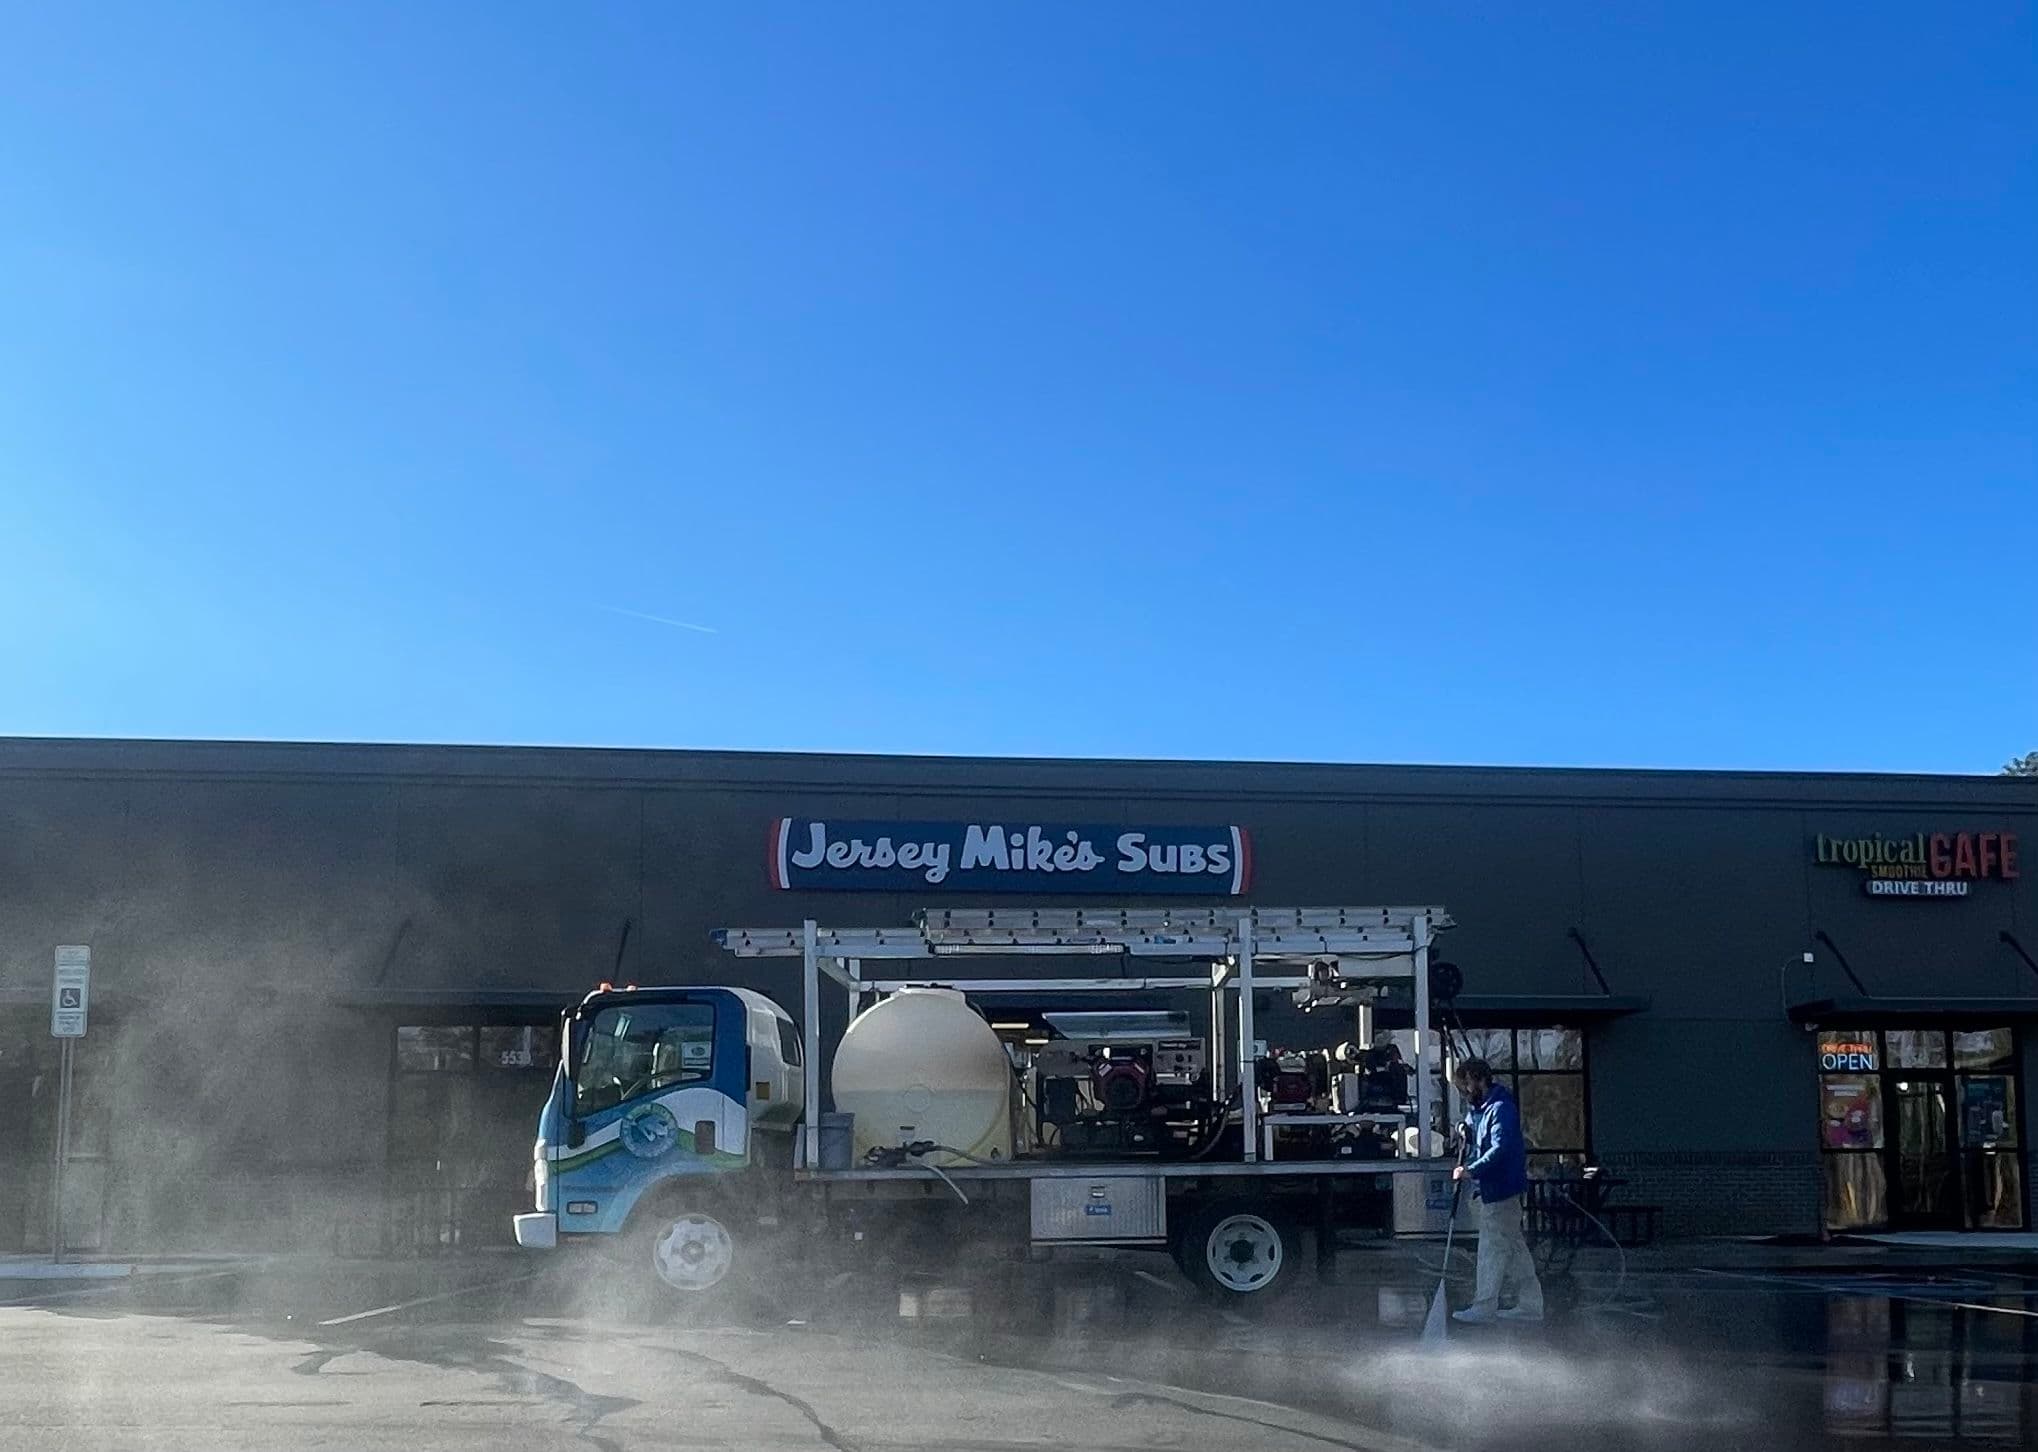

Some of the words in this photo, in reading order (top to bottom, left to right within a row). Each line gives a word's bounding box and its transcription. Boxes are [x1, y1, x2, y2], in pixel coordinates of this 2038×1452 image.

[792, 822, 950, 884] Jersey
[960, 825, 1105, 873] Mike's
[1816, 832, 1926, 869] tropical
[1930, 832, 2020, 878] CAFE
[1872, 880, 1919, 895] DRIVE
[1924, 881, 1968, 895] THRU
[1822, 1053, 1873, 1070] OPEN
